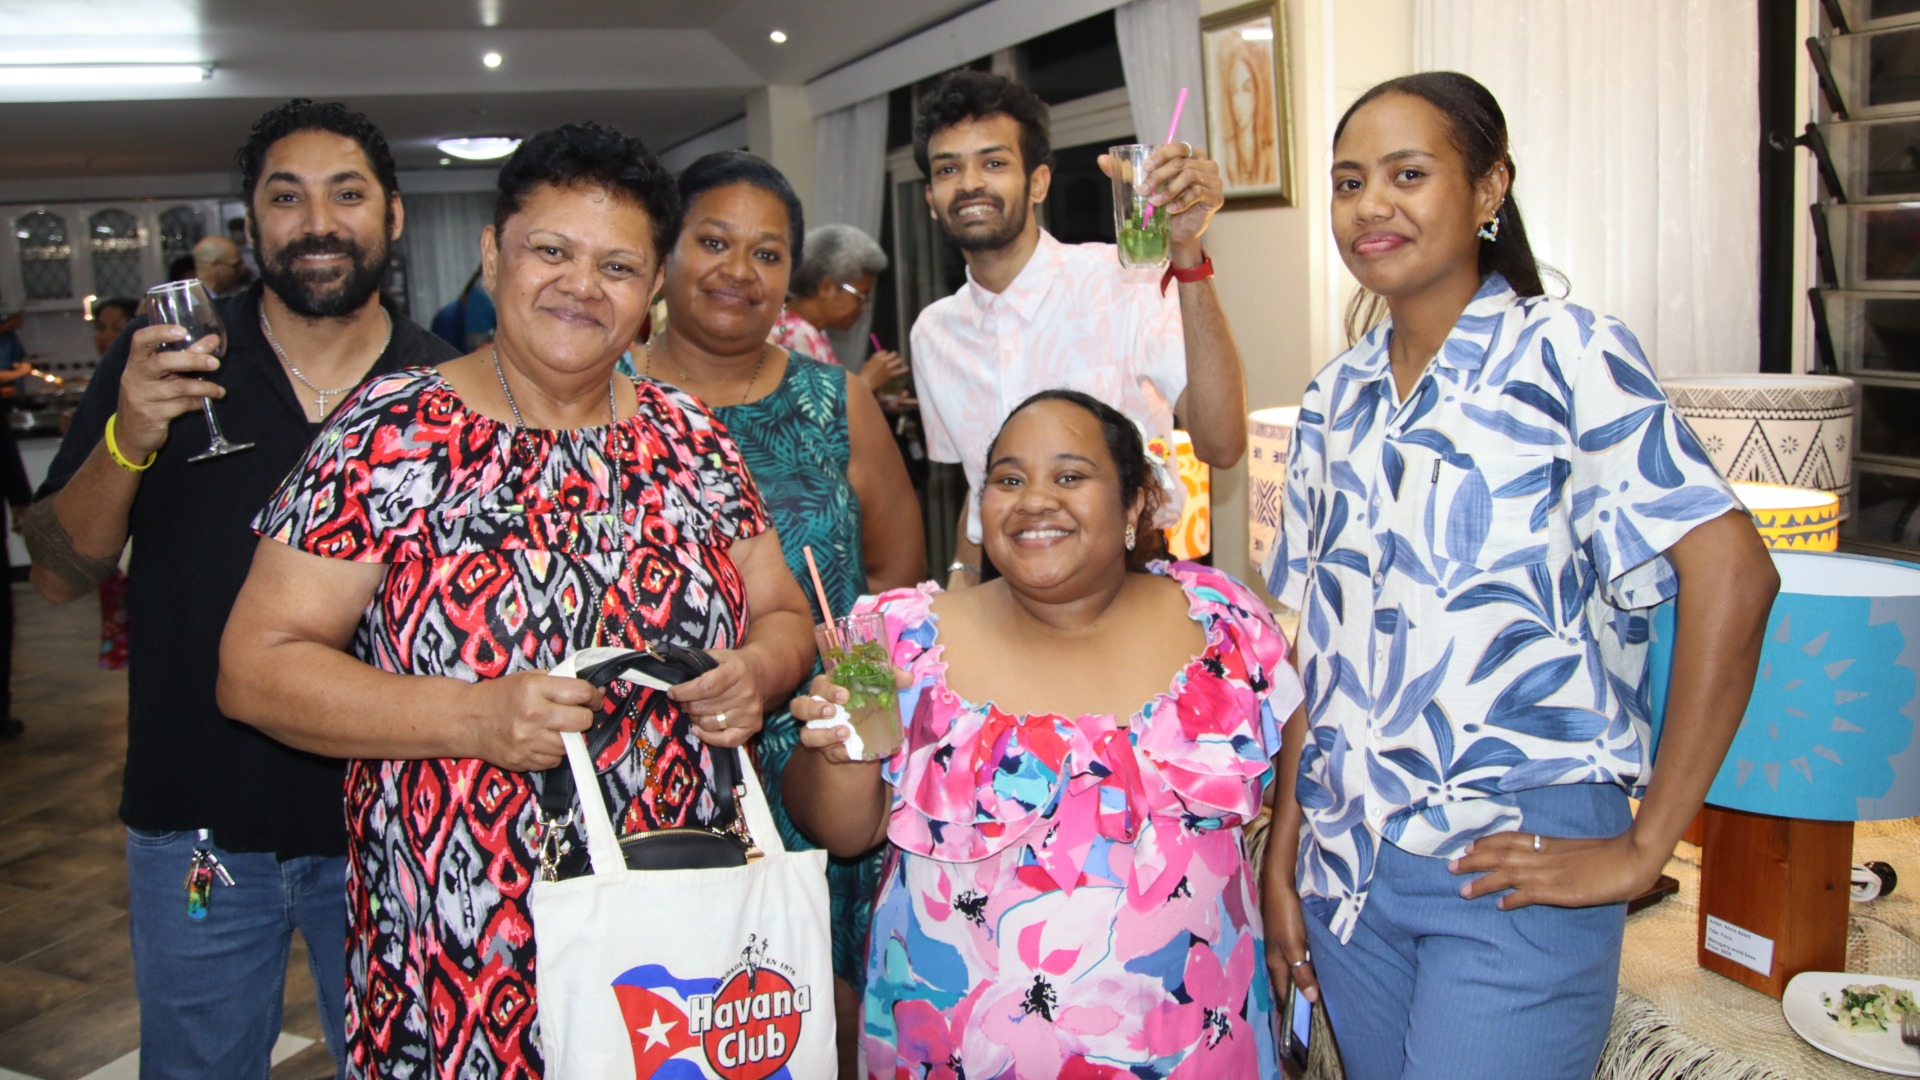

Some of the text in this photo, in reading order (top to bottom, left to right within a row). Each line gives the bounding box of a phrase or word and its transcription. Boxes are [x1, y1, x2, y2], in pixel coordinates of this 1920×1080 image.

[712, 958, 796, 991] FUNDADA EN 1878
[690, 985, 811, 1034] Havana
[717, 1024, 786, 1069] Club
